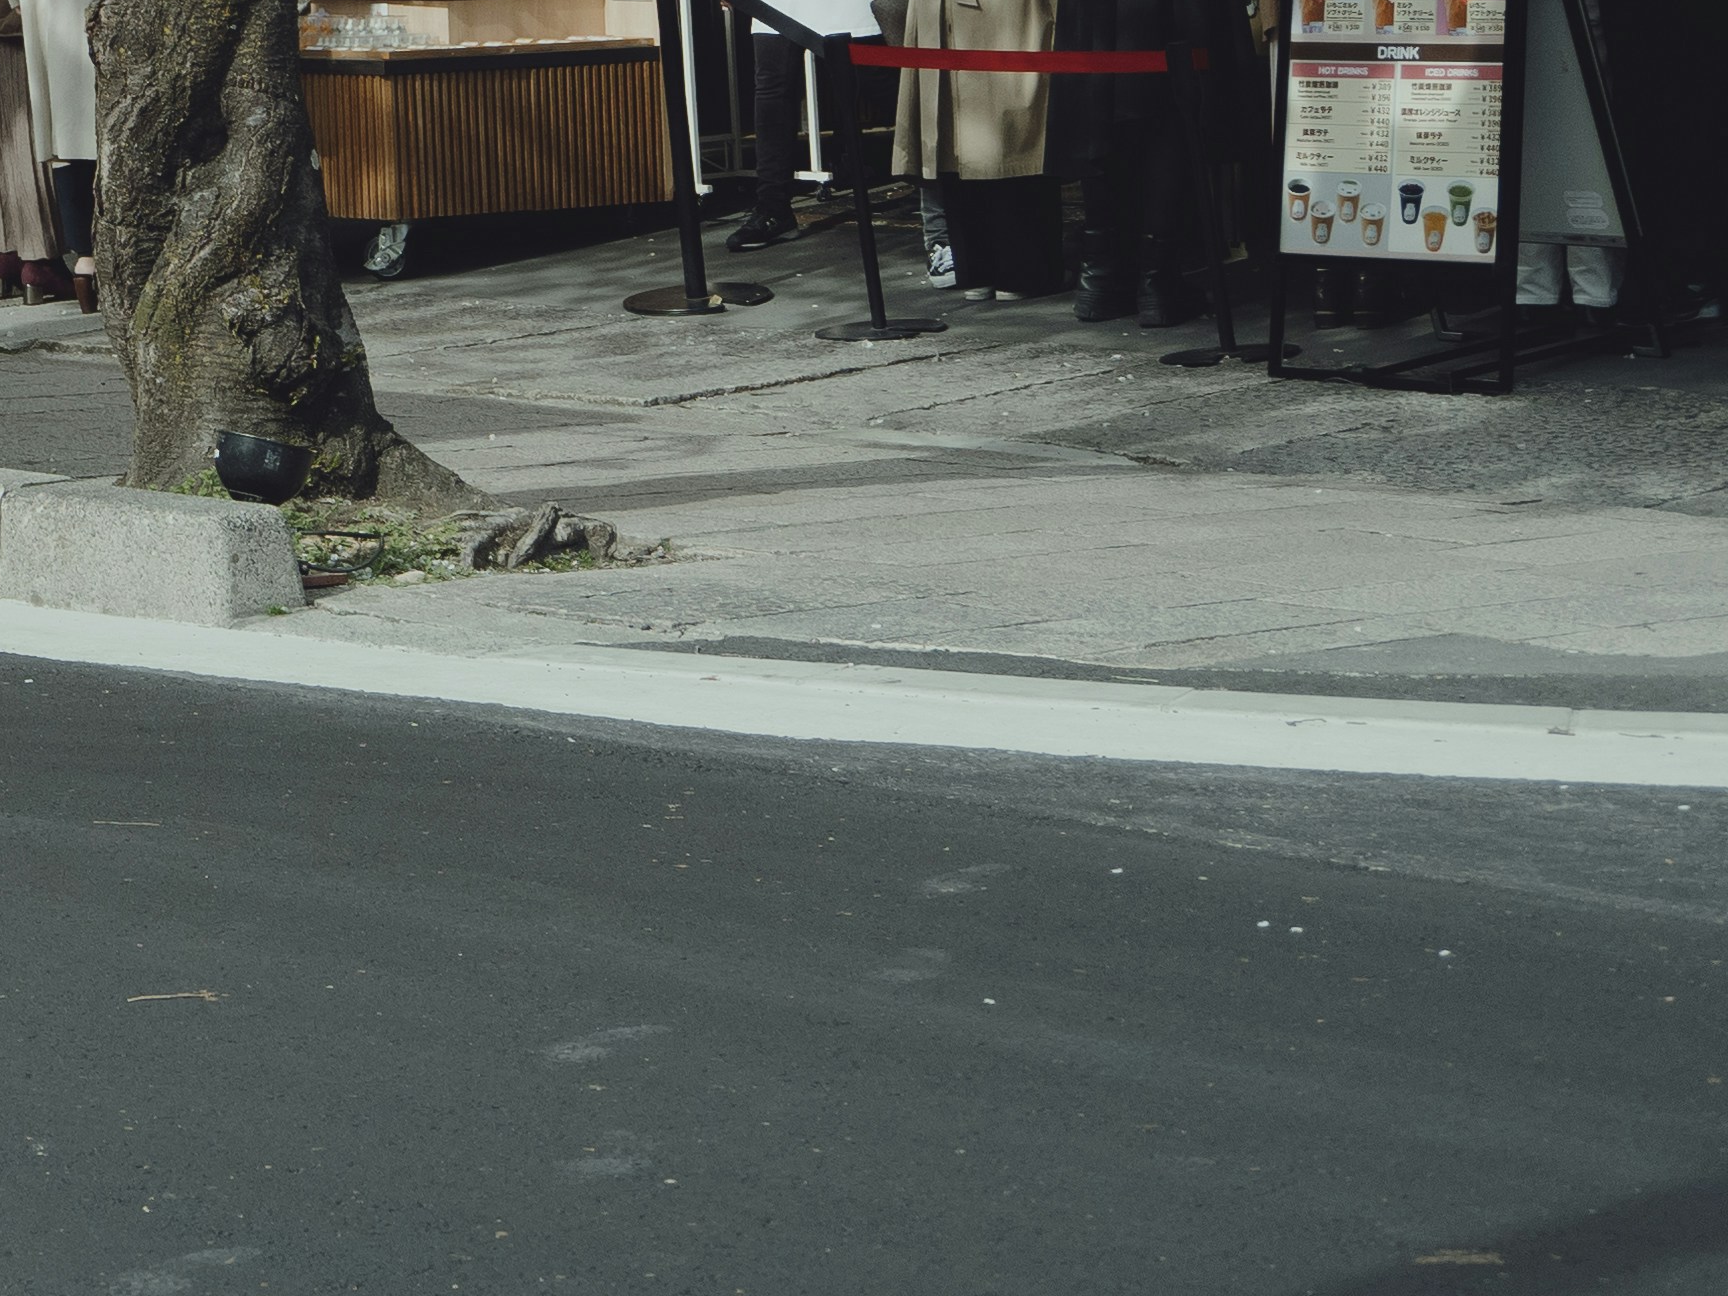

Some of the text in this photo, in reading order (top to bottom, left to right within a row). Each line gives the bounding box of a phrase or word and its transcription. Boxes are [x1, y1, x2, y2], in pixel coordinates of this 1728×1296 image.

[1377, 46, 1420, 60] DRINK
[1318, 67, 1368, 76] HOT DRINKS
[1425, 68, 1479, 77] ICED DRINKS
